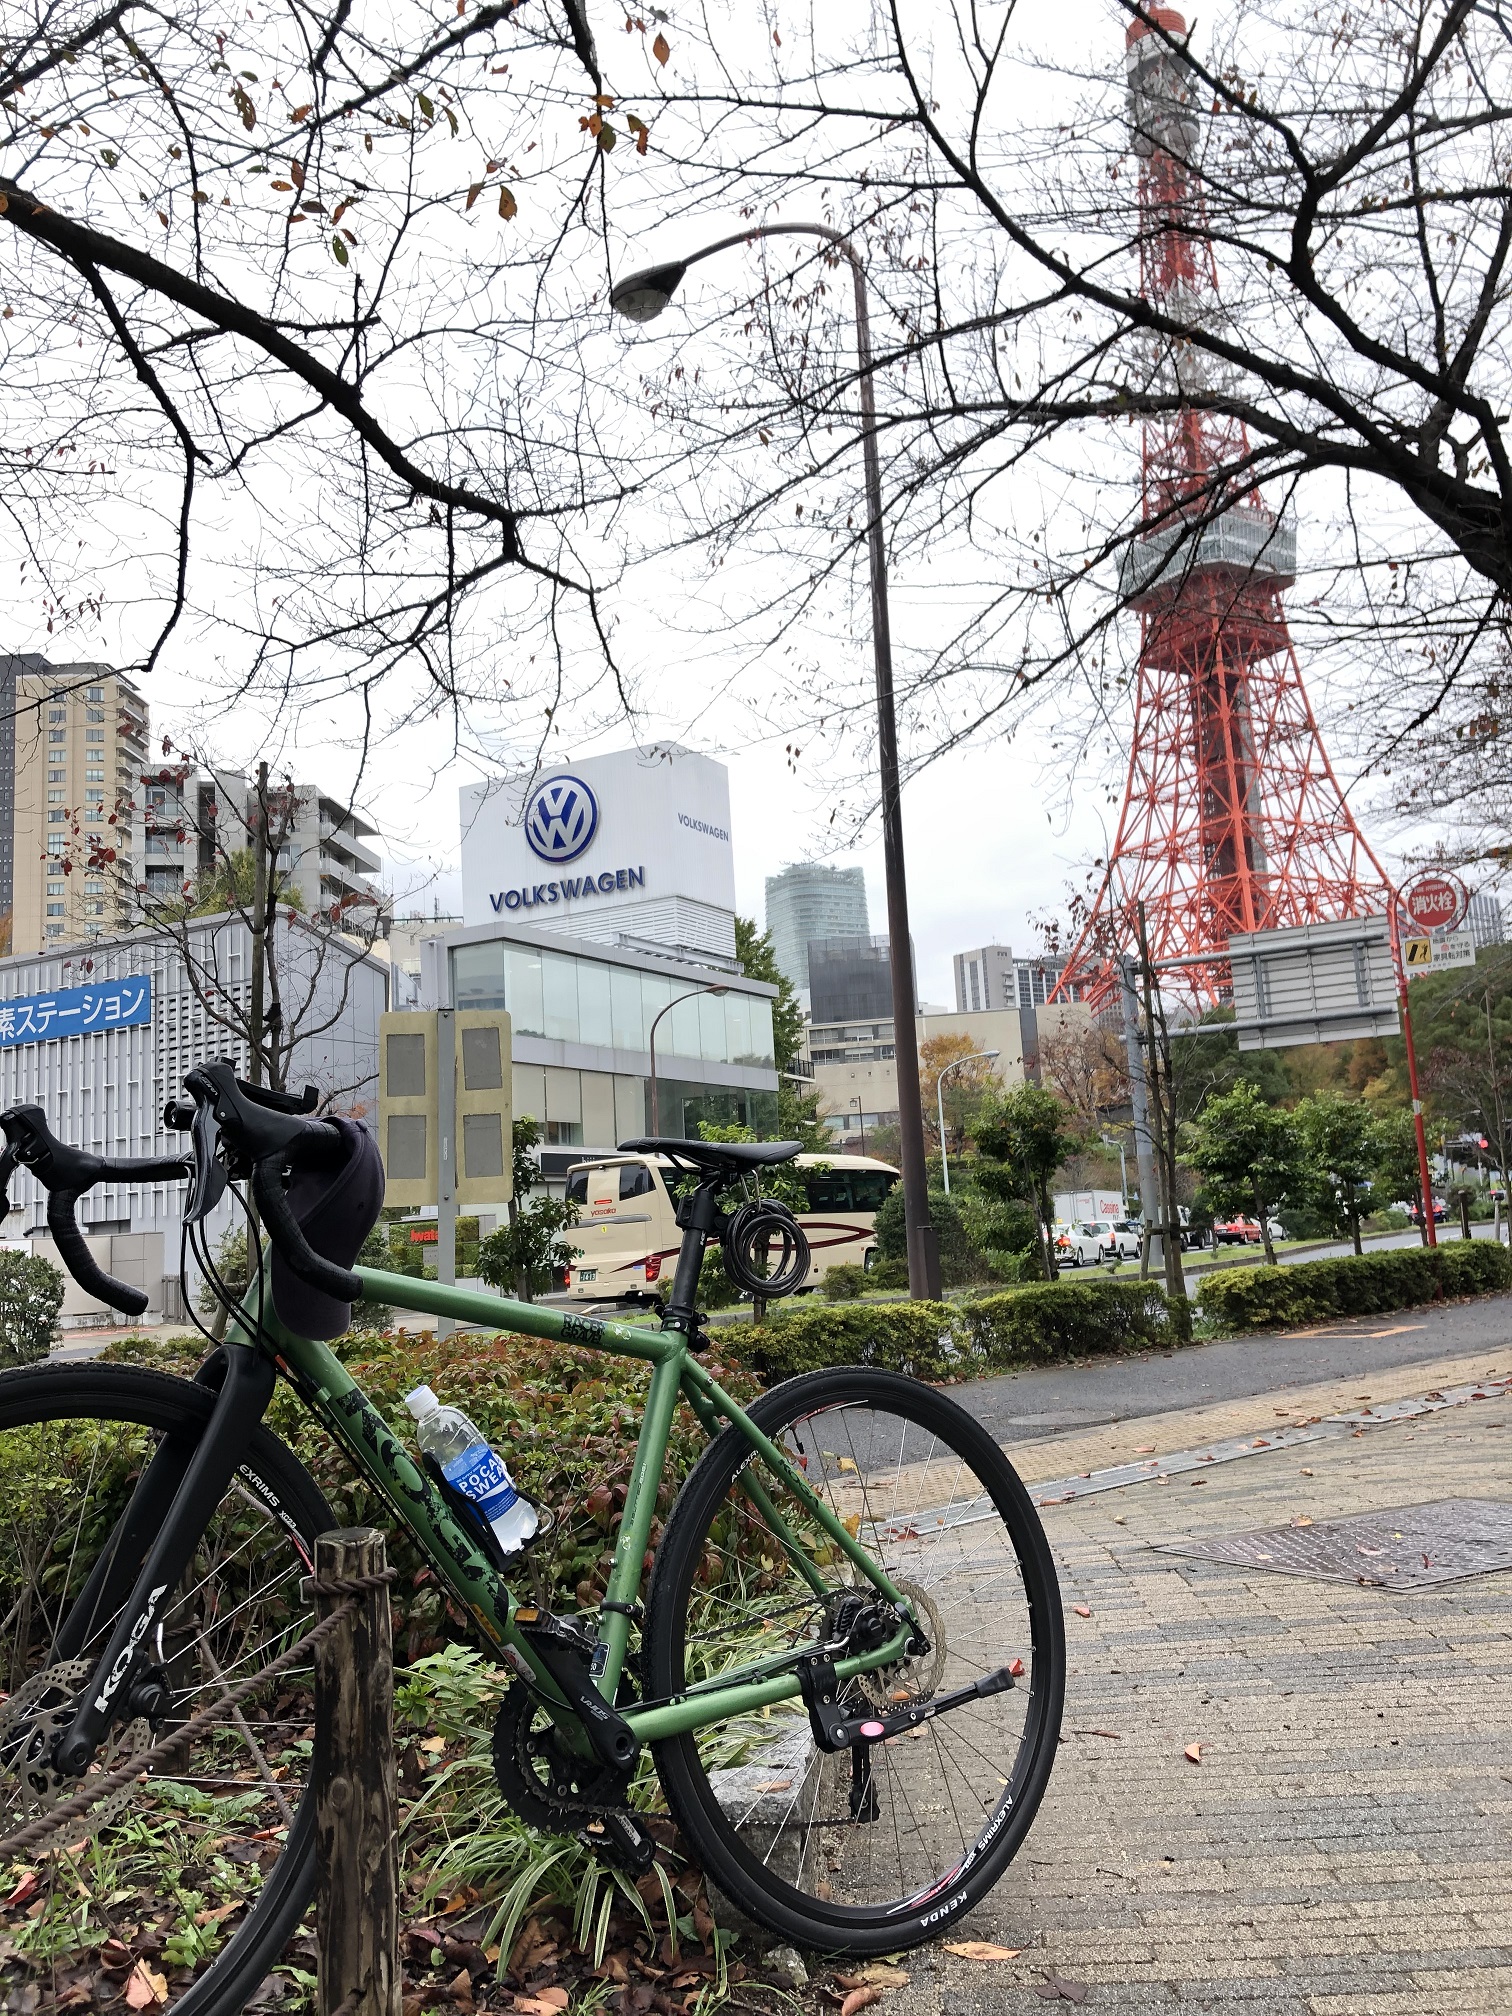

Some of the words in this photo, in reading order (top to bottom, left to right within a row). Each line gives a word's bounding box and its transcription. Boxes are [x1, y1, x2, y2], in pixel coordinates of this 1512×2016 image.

[678, 812, 729, 842] VOLKSWAGEN
[489, 866, 645, 912] VOLKSWAGEN
[1412, 891, 1453, 915] 消火栓
[0, 988, 145, 1040] 素ステーション
[1100, 1199, 1120, 1214] Cassina
[237, 1464, 281, 1507] EXRIMS
[335, 1388, 510, 1628] KOGA
[977, 1794, 1013, 1852] ALEXRIMS
[920, 1890, 968, 1928] KENDA
